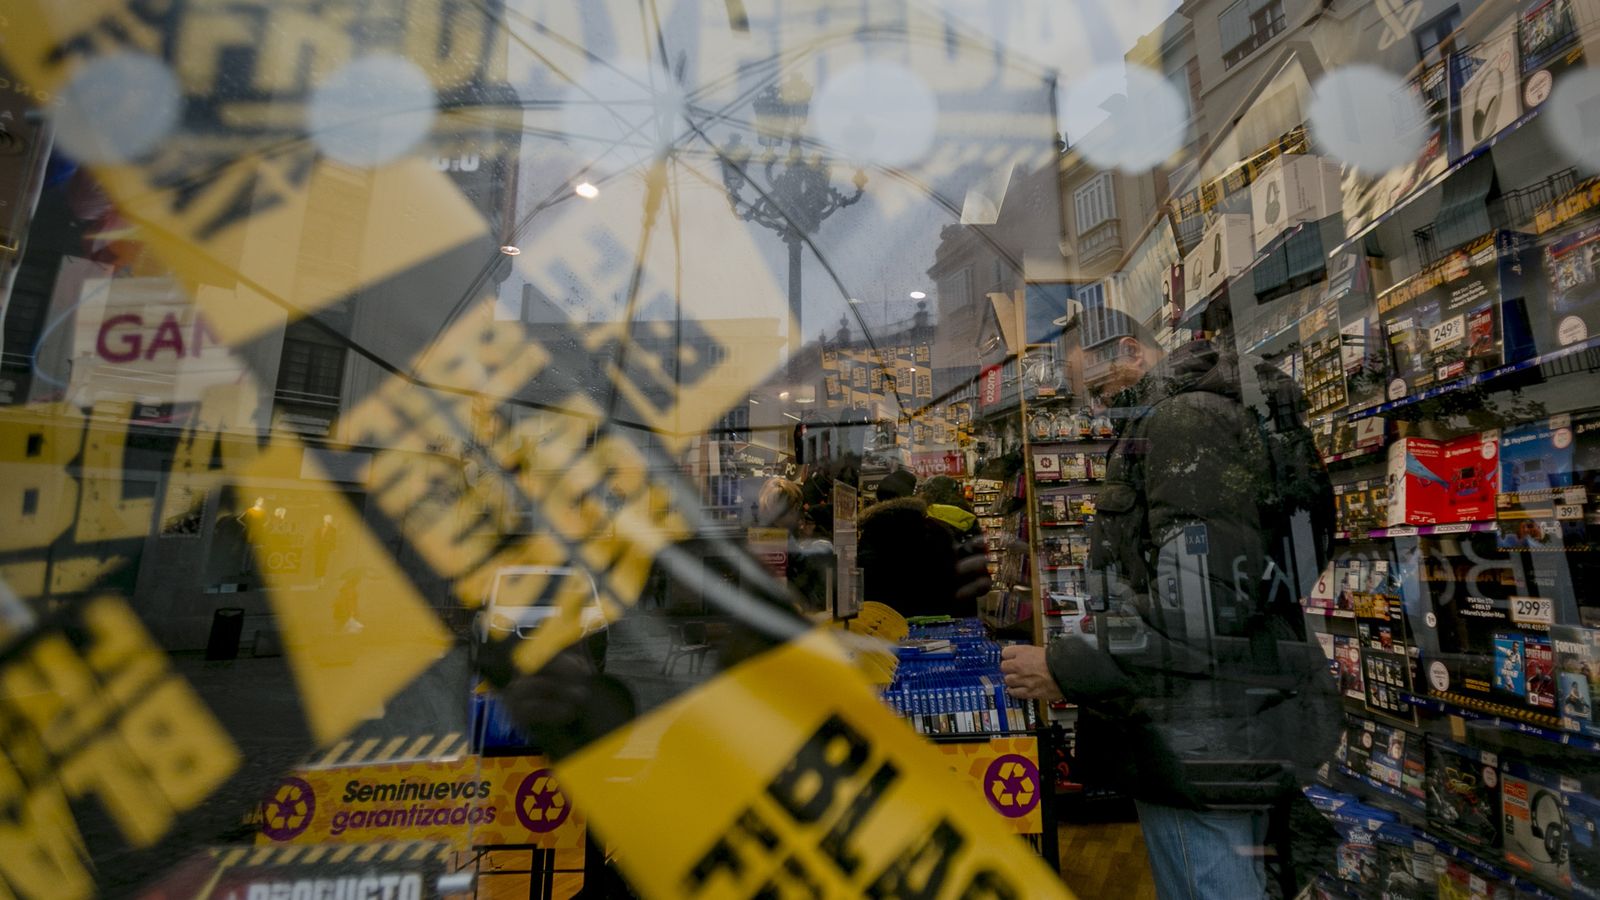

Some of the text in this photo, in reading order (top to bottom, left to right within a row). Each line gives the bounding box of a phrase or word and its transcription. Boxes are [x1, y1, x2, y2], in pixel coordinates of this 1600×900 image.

[1434, 323, 1452, 342] 249
[987, 370, 995, 402] ozone
[785, 463, 797, 475] PC
[1560, 506, 1572, 517] 39
[1517, 601, 1541, 616] 299
[343, 778, 491, 804] Seminuevos
[330, 803, 497, 835] garantizados
